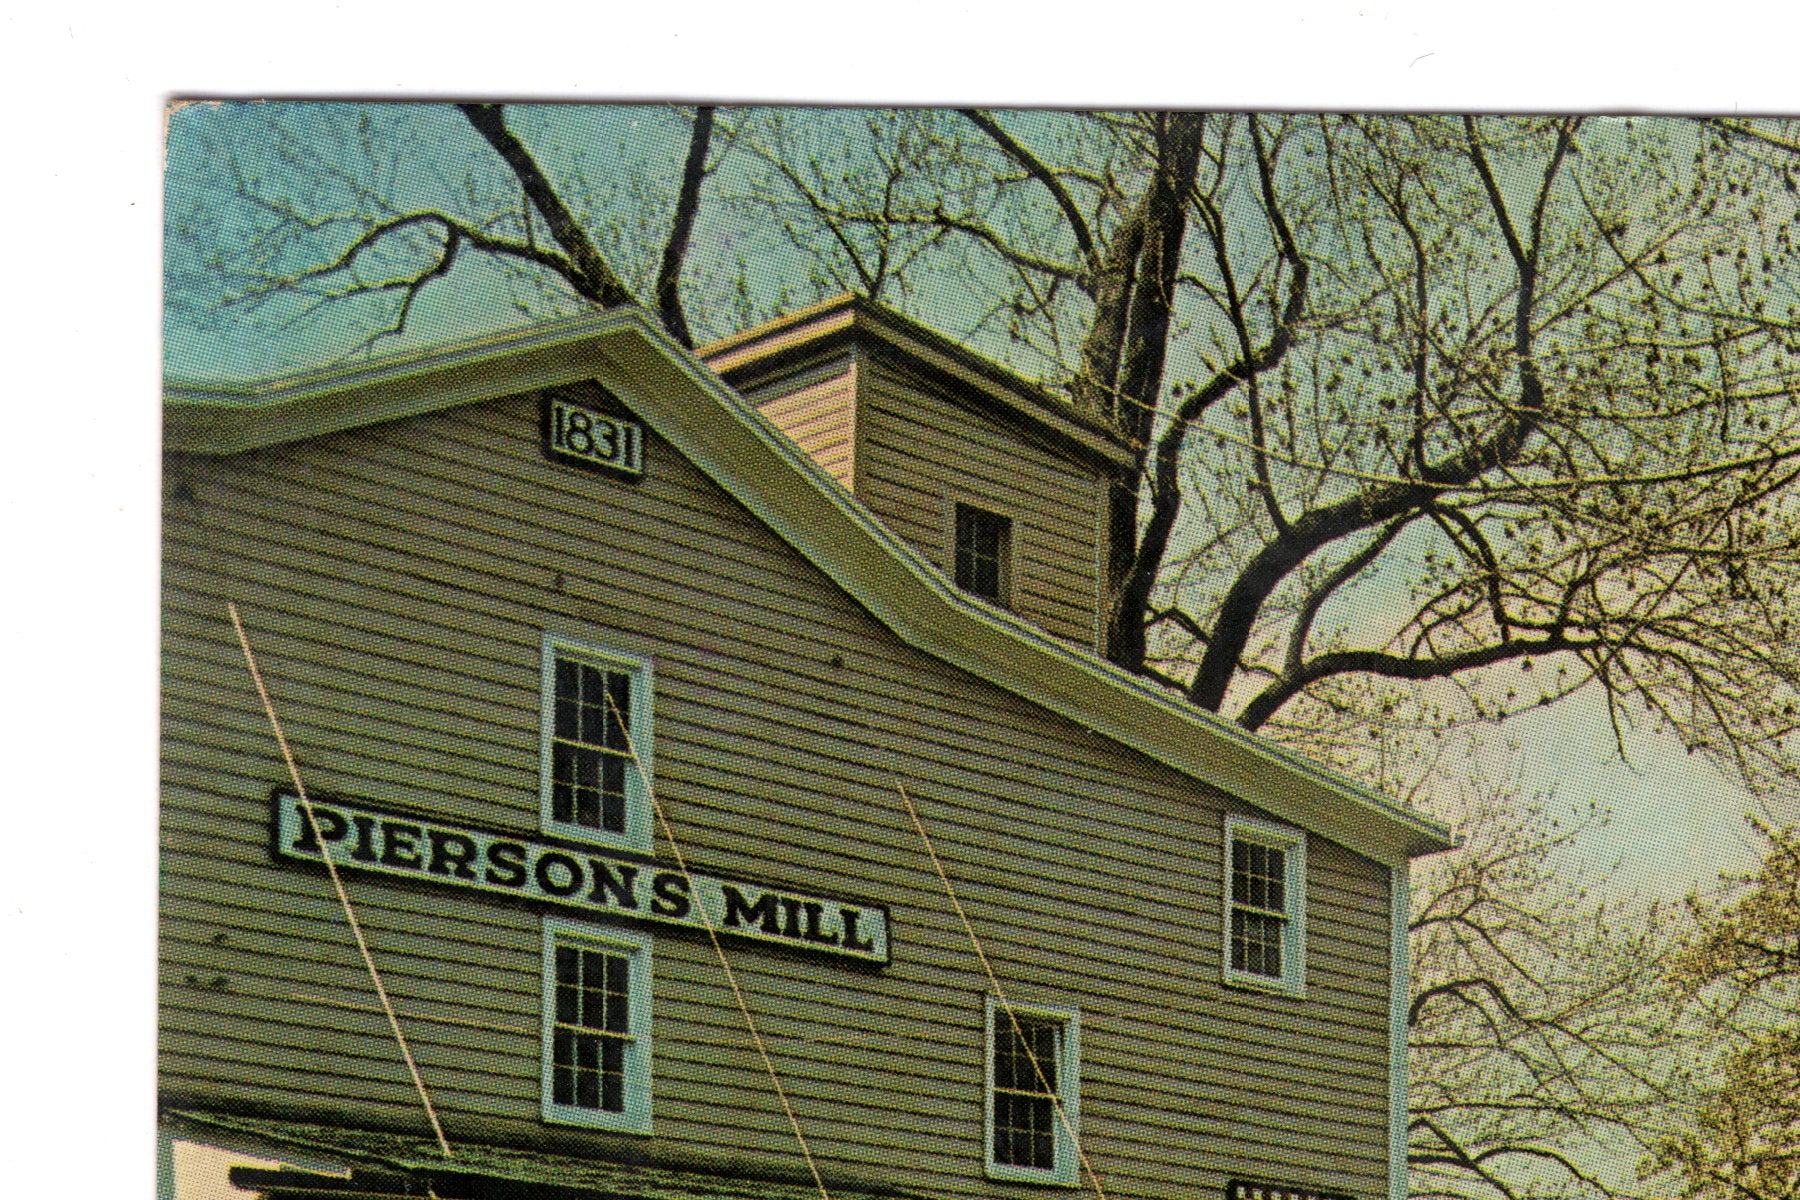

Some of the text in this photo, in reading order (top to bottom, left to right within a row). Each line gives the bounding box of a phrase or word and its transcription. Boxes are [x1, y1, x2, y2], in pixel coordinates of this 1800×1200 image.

[554, 405, 633, 467] 1831
[292, 801, 875, 952] PIERSONS MILL
